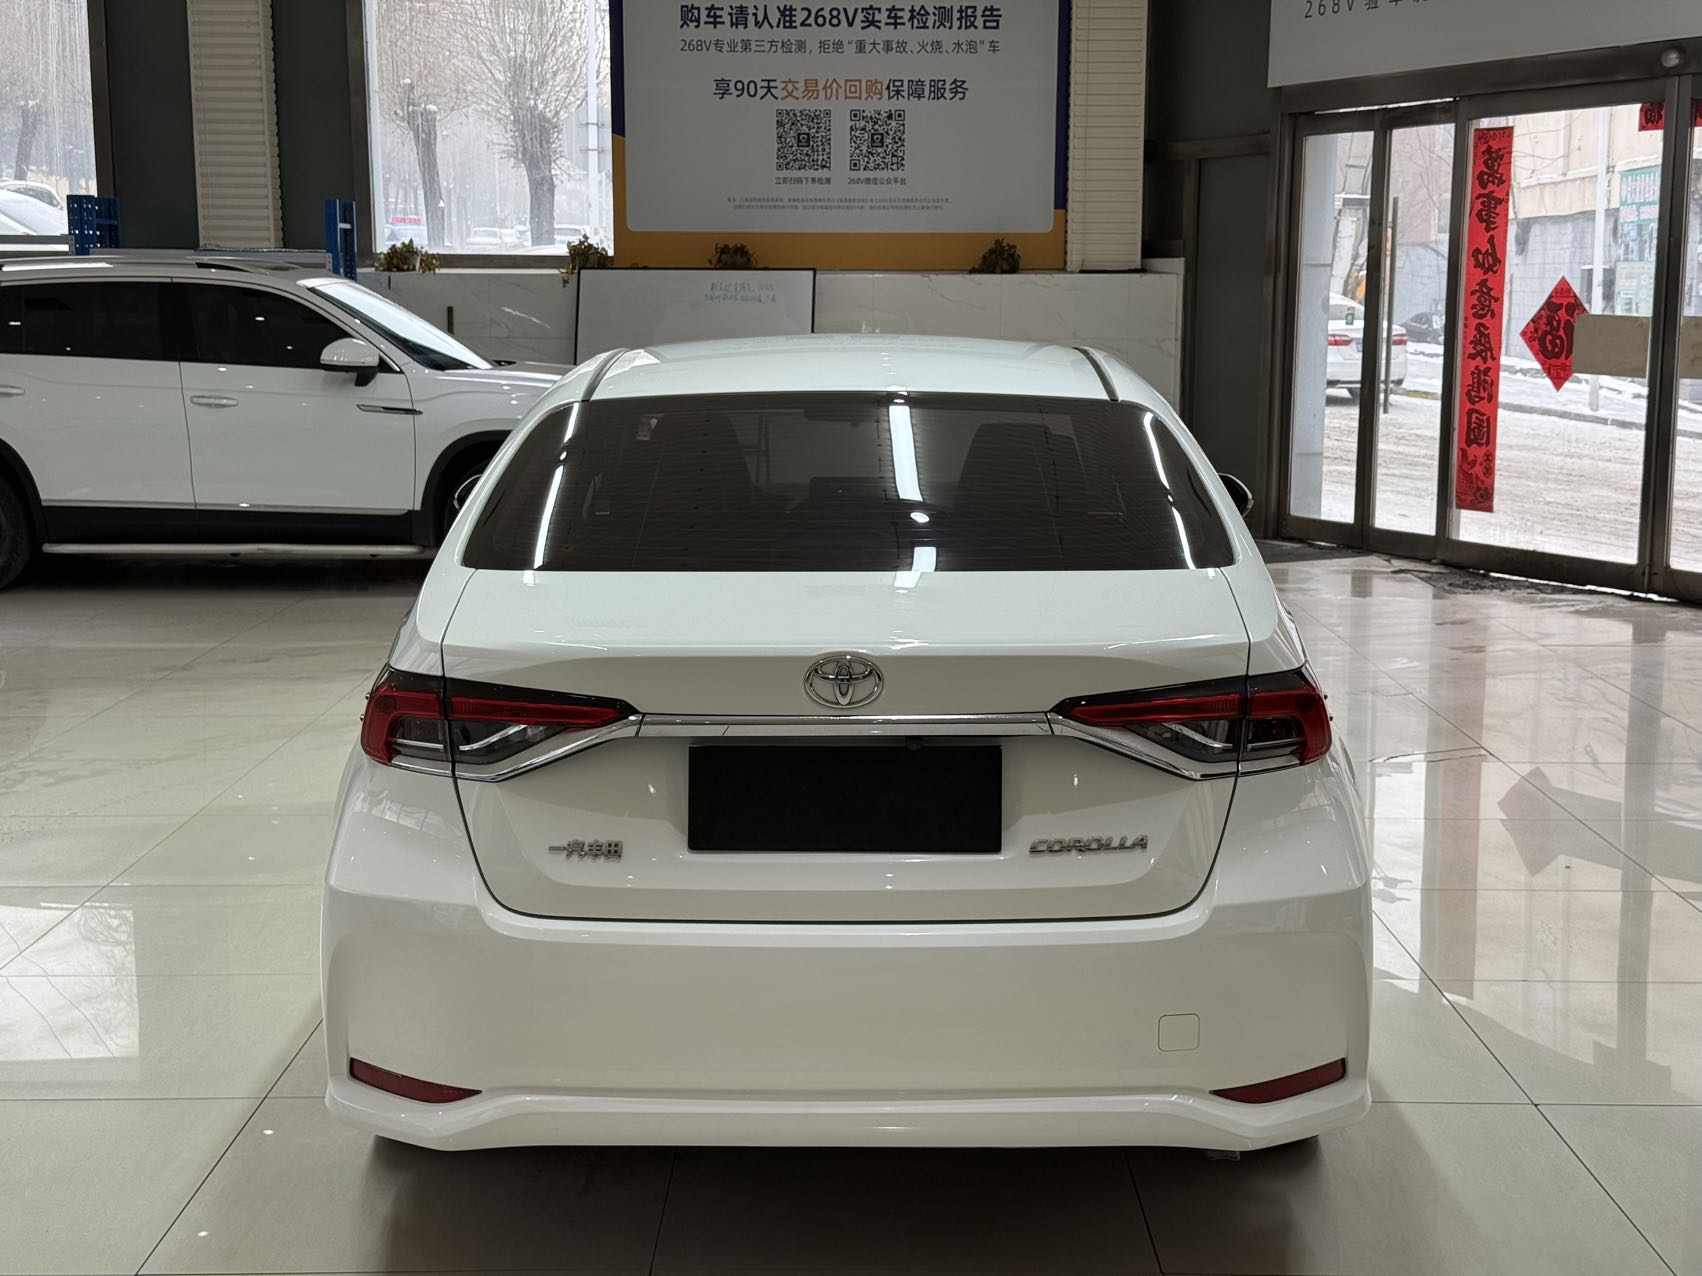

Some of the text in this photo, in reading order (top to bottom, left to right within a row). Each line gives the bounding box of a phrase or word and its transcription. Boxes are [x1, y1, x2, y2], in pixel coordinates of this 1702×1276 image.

[679, 4, 1003, 31] 购车请认准268V实车检测报告
[713, 78, 969, 101] 享90天交易价回购保障服务
[775, 177, 832, 185] 立即扫码下单检测
[847, 177, 907, 185] 268V微信公众平台
[549, 839, 623, 861] 一汽丰田
[1030, 835, 1148, 854] COROLLA
